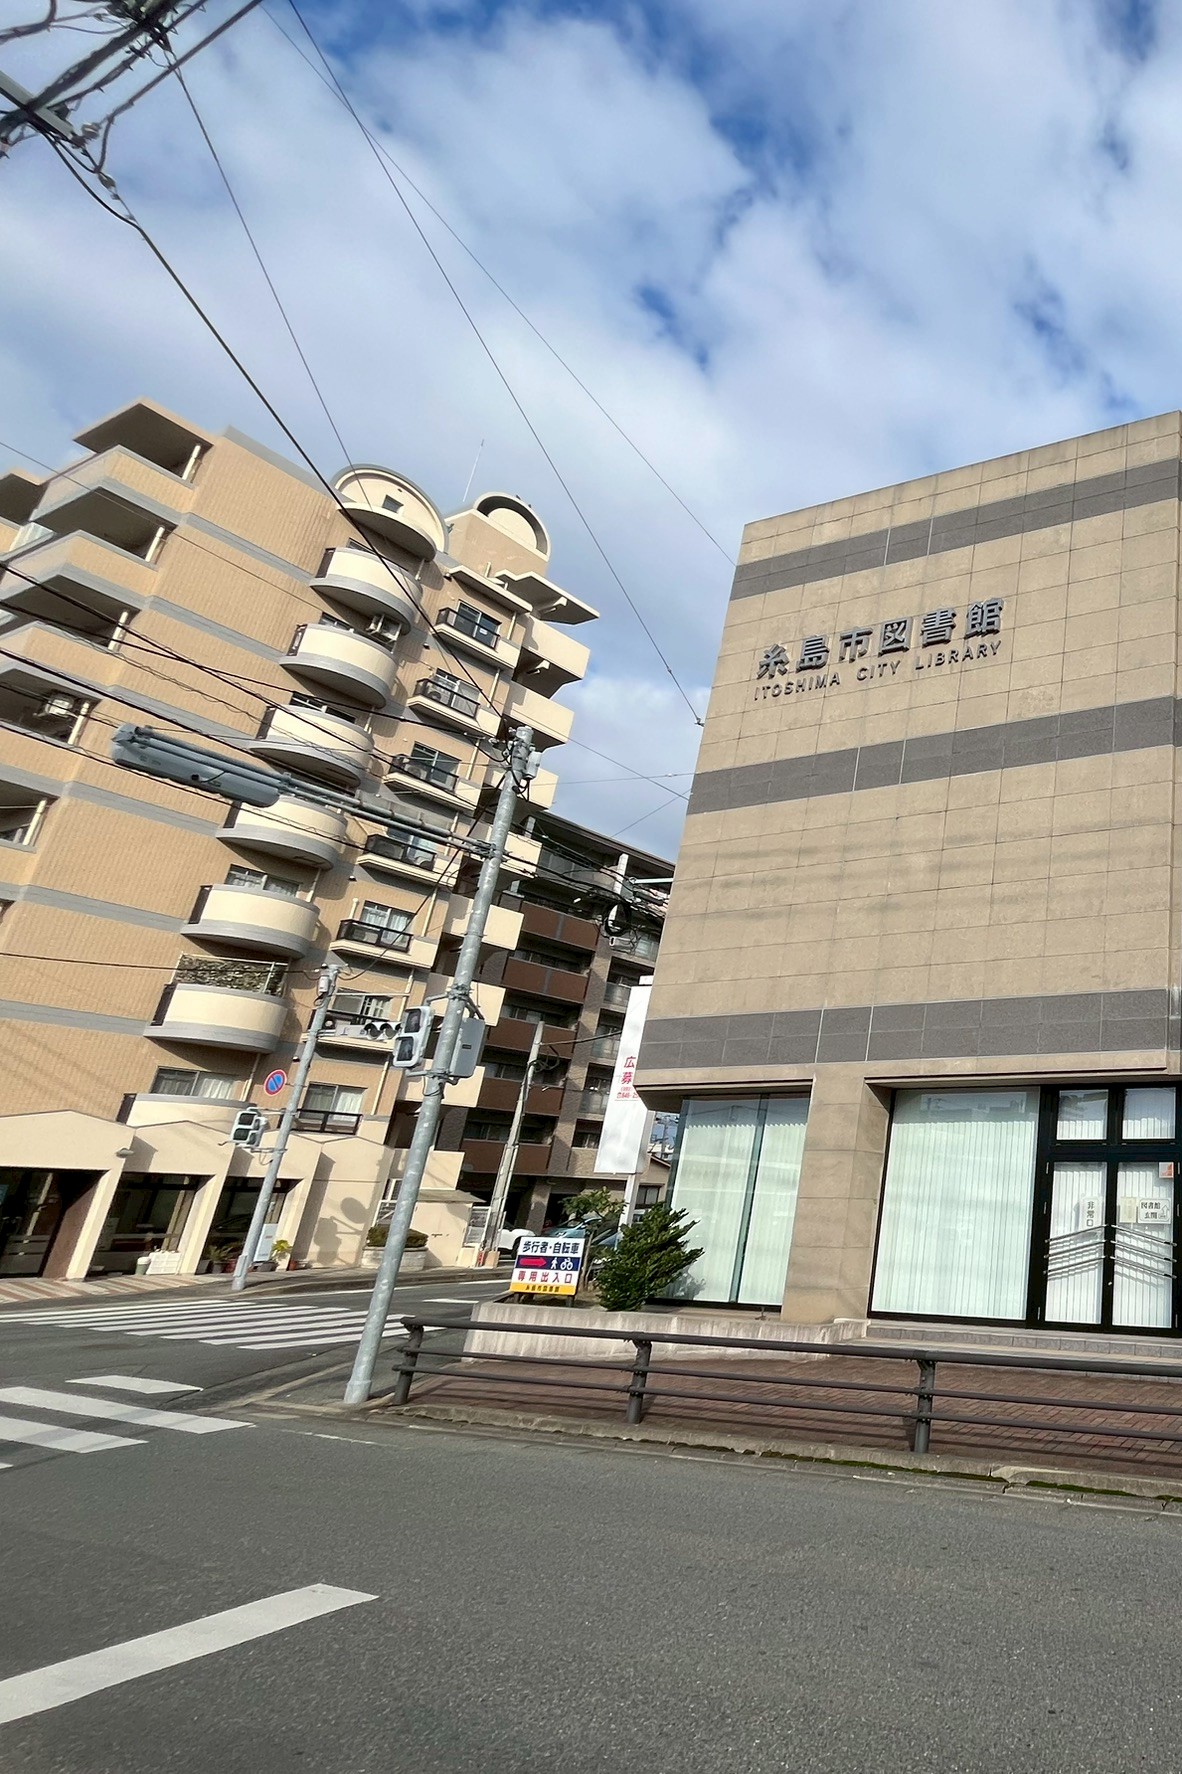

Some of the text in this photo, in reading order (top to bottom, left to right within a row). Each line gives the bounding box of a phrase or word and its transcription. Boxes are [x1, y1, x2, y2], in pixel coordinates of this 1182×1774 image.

[756, 598, 1004, 680] 糸島市図書館
[754, 640, 1002, 701] ITOSHIMA CITY LIBRARY
[522, 1241, 580, 1254] 歩行者・自転車
[518, 1270, 573, 1283] 専用出入口
